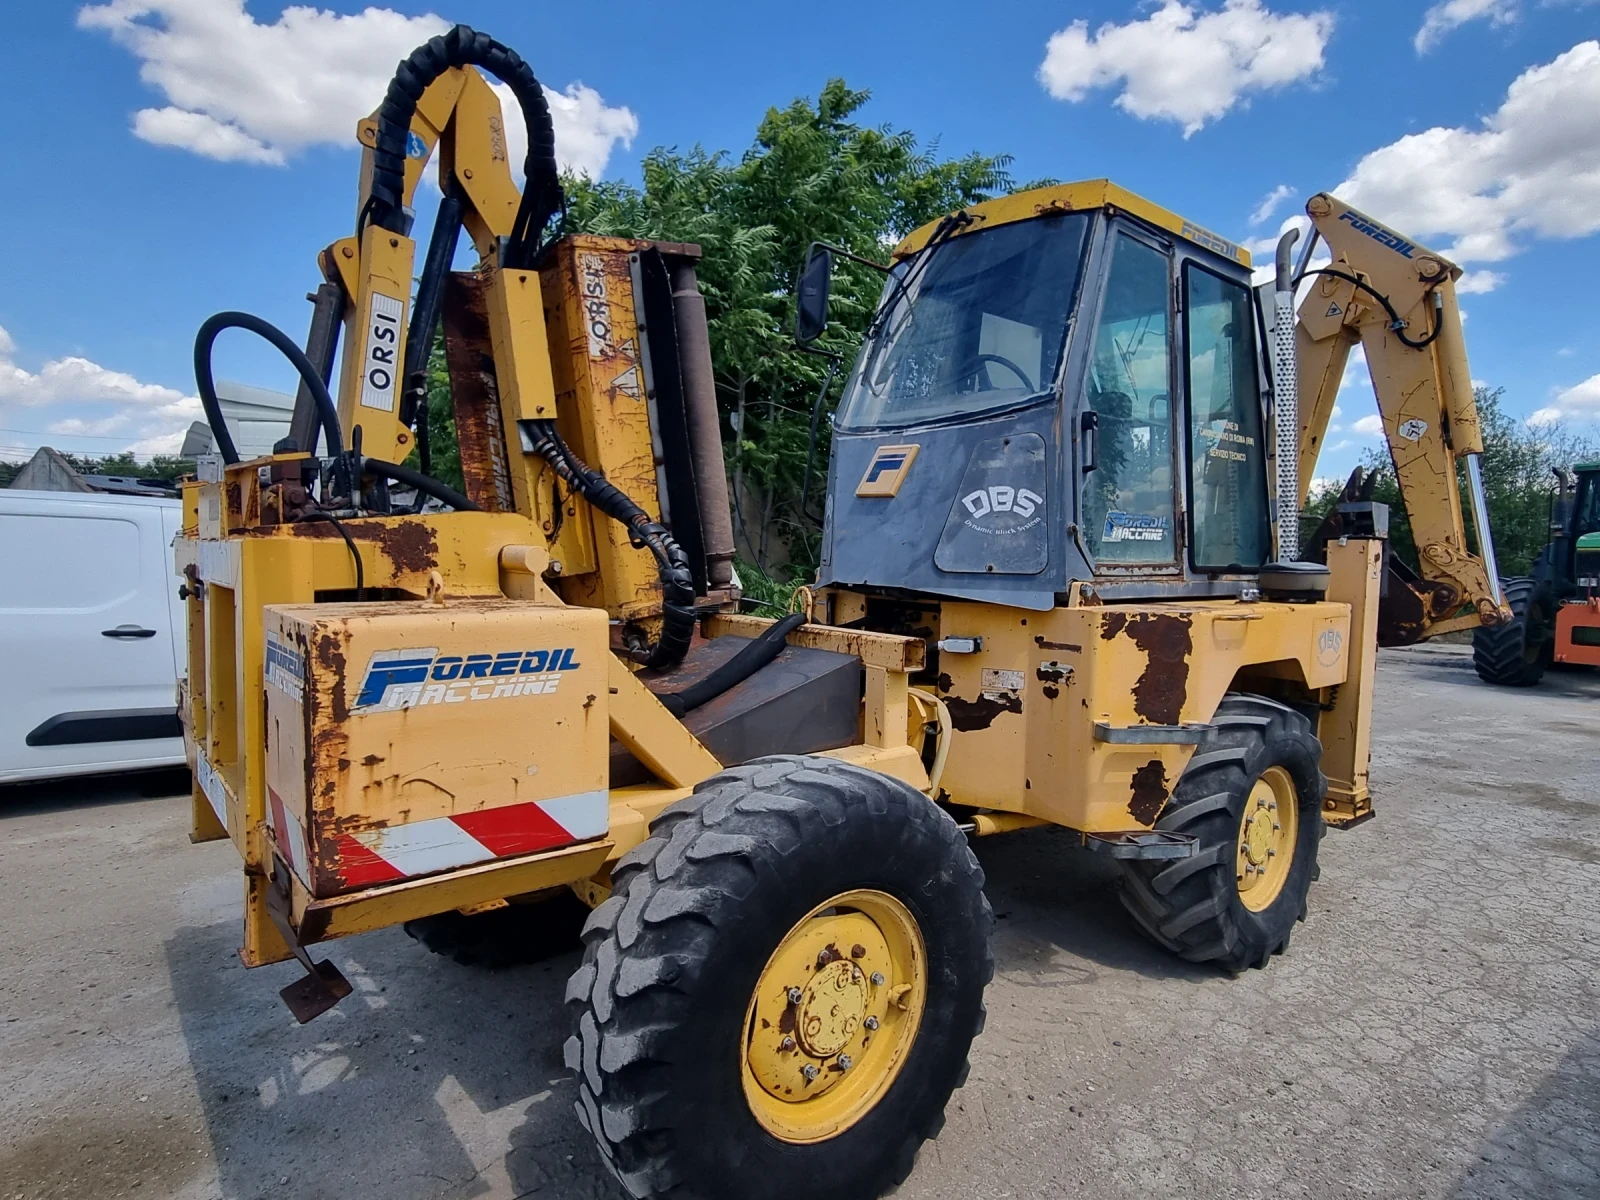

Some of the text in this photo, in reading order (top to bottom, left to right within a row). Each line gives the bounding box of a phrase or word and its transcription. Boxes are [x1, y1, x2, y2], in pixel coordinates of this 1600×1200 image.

[1338, 210, 1415, 259] FOREDIL
[585, 270, 611, 340] ORSI
[369, 313, 397, 390] ORSI
[1210, 448, 1246, 461] SERVIZIO TECNICO
[1234, 433, 1245, 443] ROMA
[962, 486, 1043, 519] DBS
[964, 519, 993, 535] Dynamic
[1017, 516, 1041, 532] System
[1111, 526, 1164, 540] MACCHINE
[356, 648, 580, 706] FOREDIL
[387, 674, 561, 708] MACCHINE
